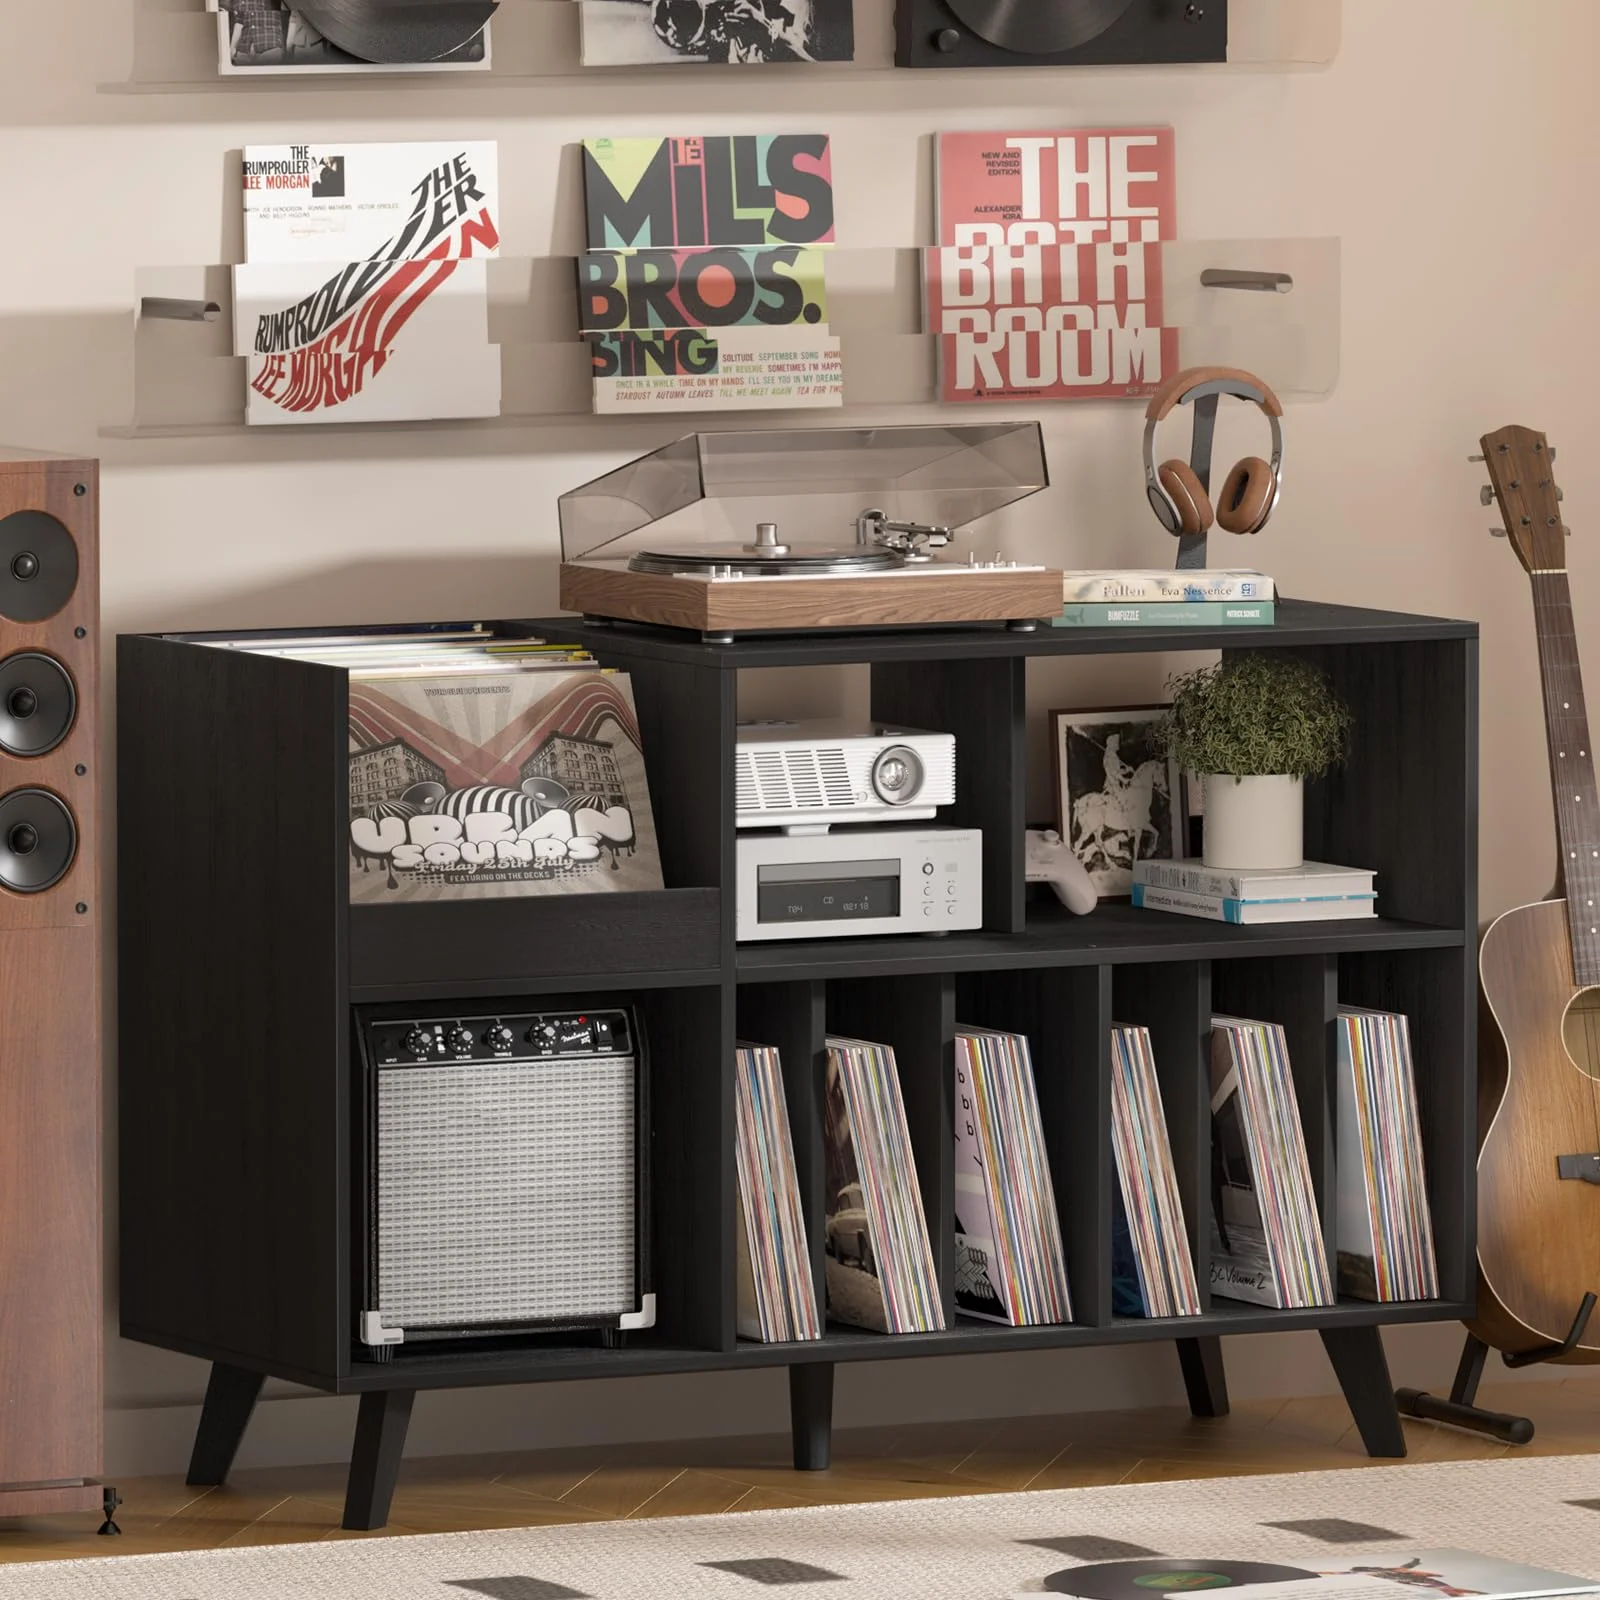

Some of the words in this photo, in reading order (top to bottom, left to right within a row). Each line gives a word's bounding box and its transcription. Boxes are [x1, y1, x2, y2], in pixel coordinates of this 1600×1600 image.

[290, 146, 309, 159] THE
[243, 161, 309, 175] RUMPROLLER
[243, 175, 262, 189] LEE
[266, 175, 309, 189] MORGAN
[1006, 136, 1159, 219] THE
[584, 134, 835, 249] MILLS
[974, 205, 1022, 213] ALEXANDER
[941, 221, 1160, 306] BATH
[579, 244, 822, 331] BROS.
[593, 329, 718, 378] SING
[942, 303, 1162, 389] ROOM
[722, 353, 753, 362] SOLITUDE
[758, 352, 798, 360] SEPTEMBER
[801, 351, 819, 360] SONG
[722, 366, 732, 374] MY
[735, 365, 764, 373] REVERIE
[768, 363, 806, 372] SOMETIMES
[809, 363, 818, 371] I'M
[821, 362, 842, 371] HAPPY
[616, 380, 633, 388] ONCE
[636, 380, 643, 388] IN
[645, 380, 651, 388] A
[653, 379, 674, 387] WHILE
[678, 379, 695, 387] TIME
[697, 378, 706, 386] ON
[708, 378, 719, 386] MY
[721, 377, 744, 385] HANDS
[763, 376, 775, 384] SEE
[778, 375, 791, 383] YOU
[793, 375, 800, 383] IN
[803, 374, 813, 383] MY
[616, 391, 651, 400] STARDUST
[656, 390, 685, 399] AUTUMN
[688, 390, 713, 399] LEAVES
[720, 389, 733, 397] TILL
[736, 388, 747, 396] WE
[749, 387, 768, 396] MEET
[771, 386, 792, 395] AGAIN
[797, 386, 810, 395] TEA
[812, 385, 827, 394] FOR
[1103, 586, 1145, 597] Fallen
[1161, 587, 1179, 596] Eva
[351, 806, 634, 854] URBAN
[391, 836, 600, 869] SOUNDS
[414, 861, 480, 874] Friday
[533, 855, 577, 870] July
[449, 872, 493, 882] FEATURING
[495, 873, 506, 881] ON
[508, 872, 522, 880] THE
[523, 871, 550, 879] DECKS
[823, 896, 834, 904] CD
[1256, 1272, 1266, 1290] 2
